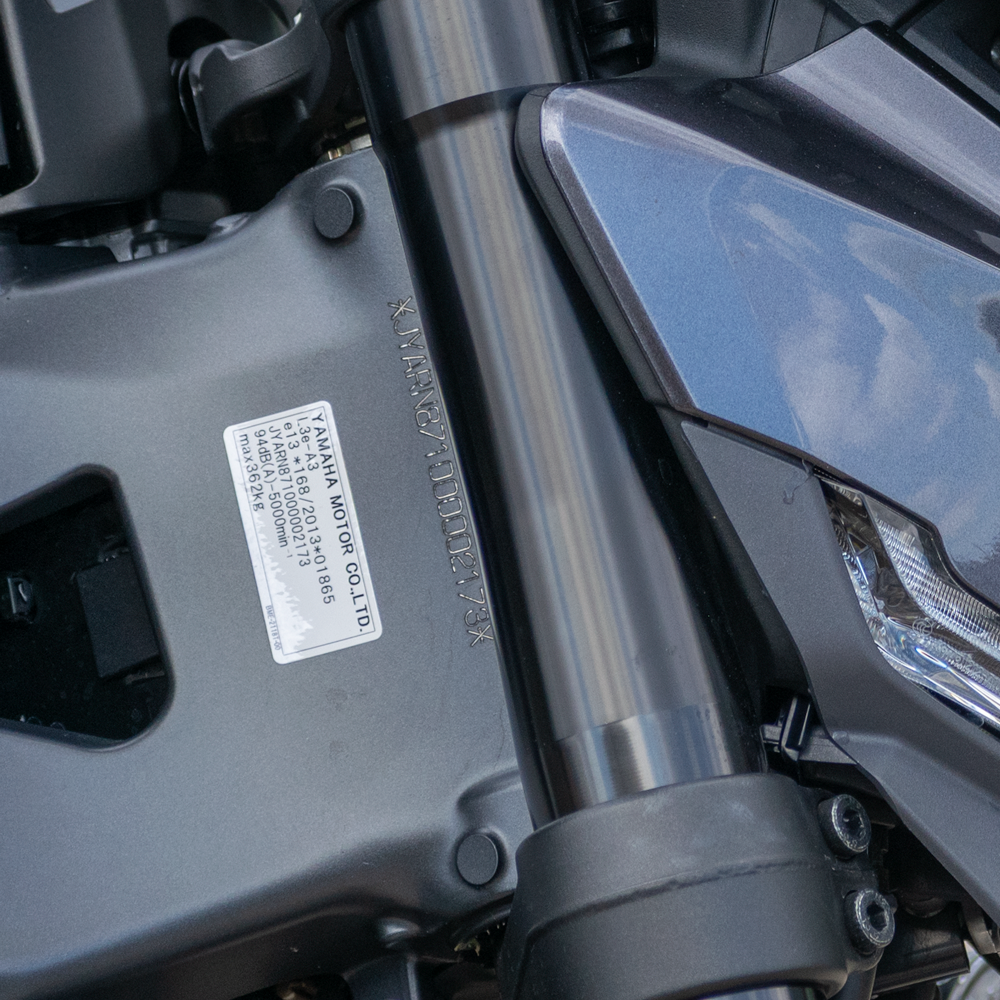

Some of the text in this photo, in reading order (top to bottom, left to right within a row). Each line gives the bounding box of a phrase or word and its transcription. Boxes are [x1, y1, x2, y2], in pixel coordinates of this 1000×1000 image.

[238, 433, 265, 512] max362kg
[283, 421, 301, 450] e13
[296, 416, 320, 472] L3e-A3
[268, 425, 311, 568] JYARN871000002173
[311, 411, 372, 633] YAMAHA MOTOR CO.,LTD.
